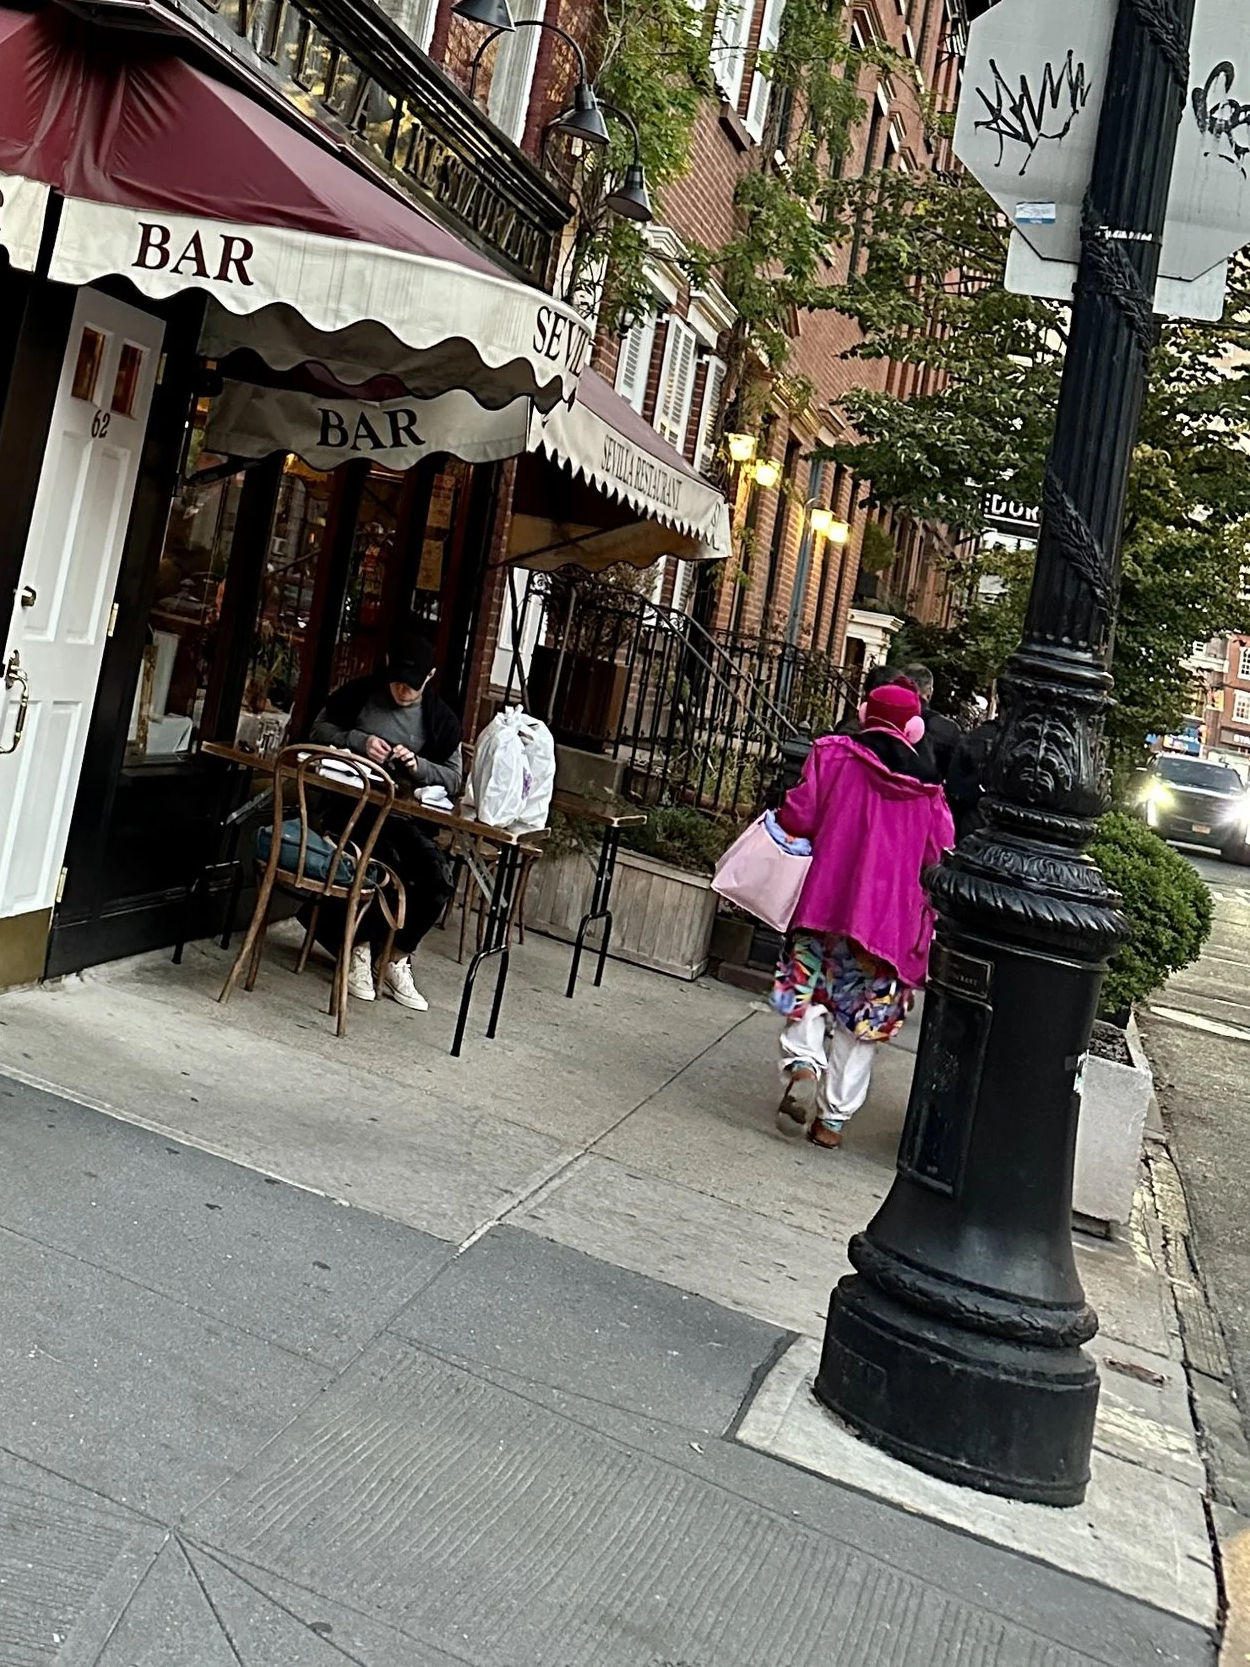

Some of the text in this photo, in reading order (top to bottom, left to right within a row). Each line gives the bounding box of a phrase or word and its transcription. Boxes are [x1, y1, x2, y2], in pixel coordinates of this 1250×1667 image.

[133, 222, 255, 287] BAR
[91, 409, 111, 439] 62
[316, 407, 426, 450] BAR
[600, 434, 683, 511] SEVILLA RESTAURANT
